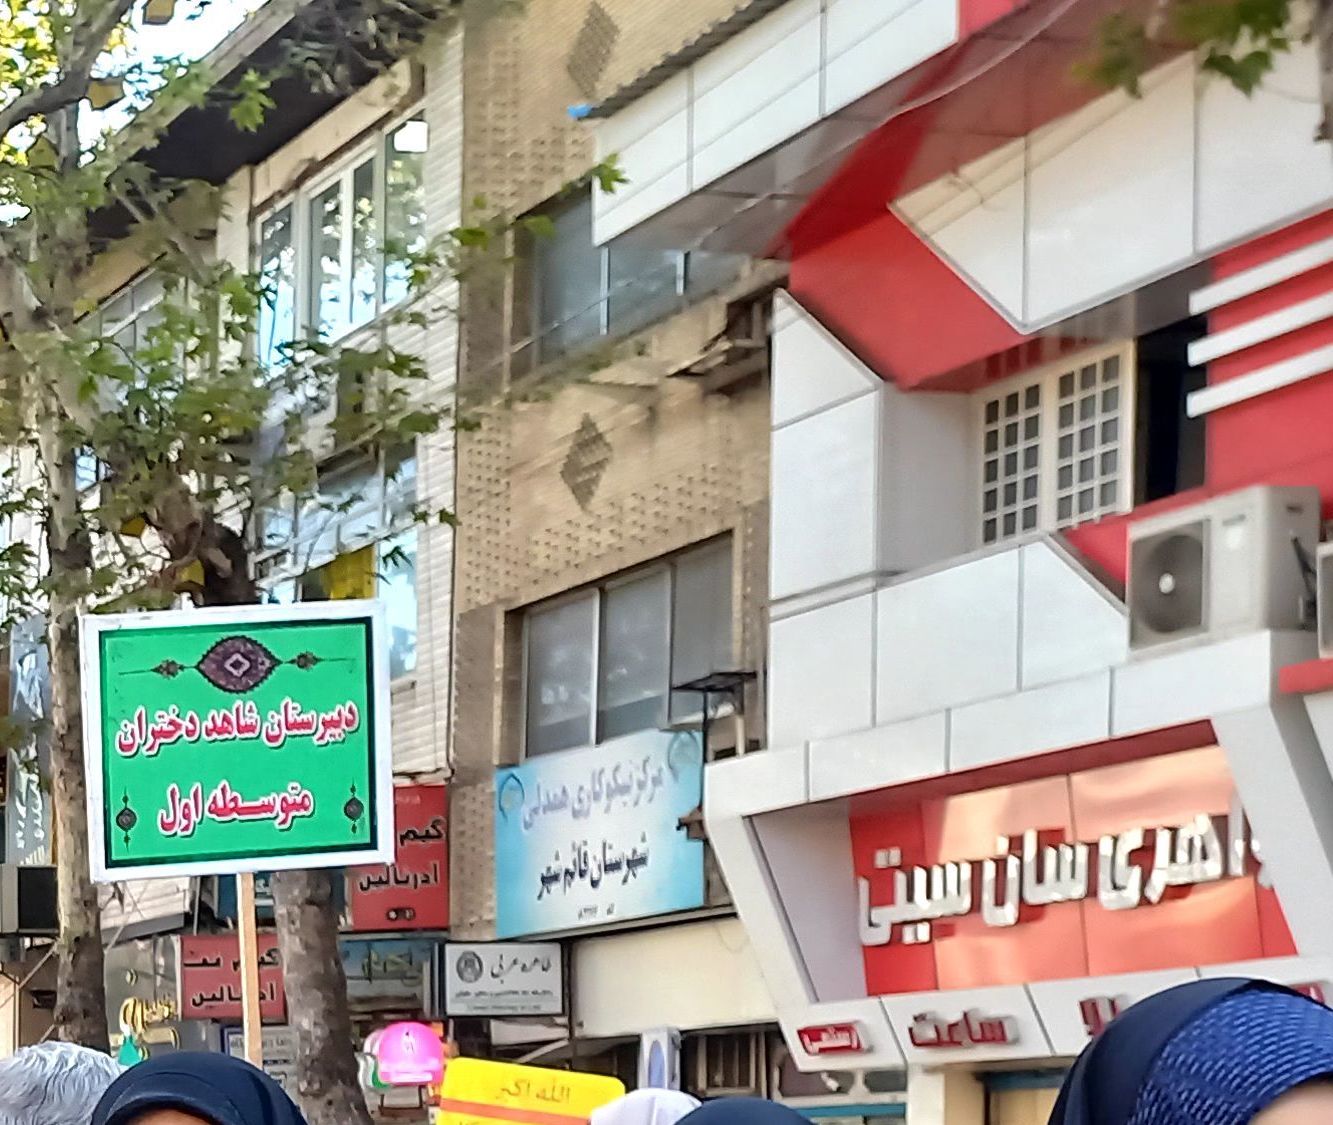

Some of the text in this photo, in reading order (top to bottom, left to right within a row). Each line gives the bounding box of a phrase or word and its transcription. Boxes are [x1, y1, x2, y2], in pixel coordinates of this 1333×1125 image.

[118, 700, 358, 753] دبیرستان شاهد دختران
[160, 781, 313, 833] متوسطه اول
[537, 851, 561, 901] شهر
[590, 831, 649, 888] شهرستان
[982, 828, 1088, 926] سان
[858, 846, 973, 946] سیتی
